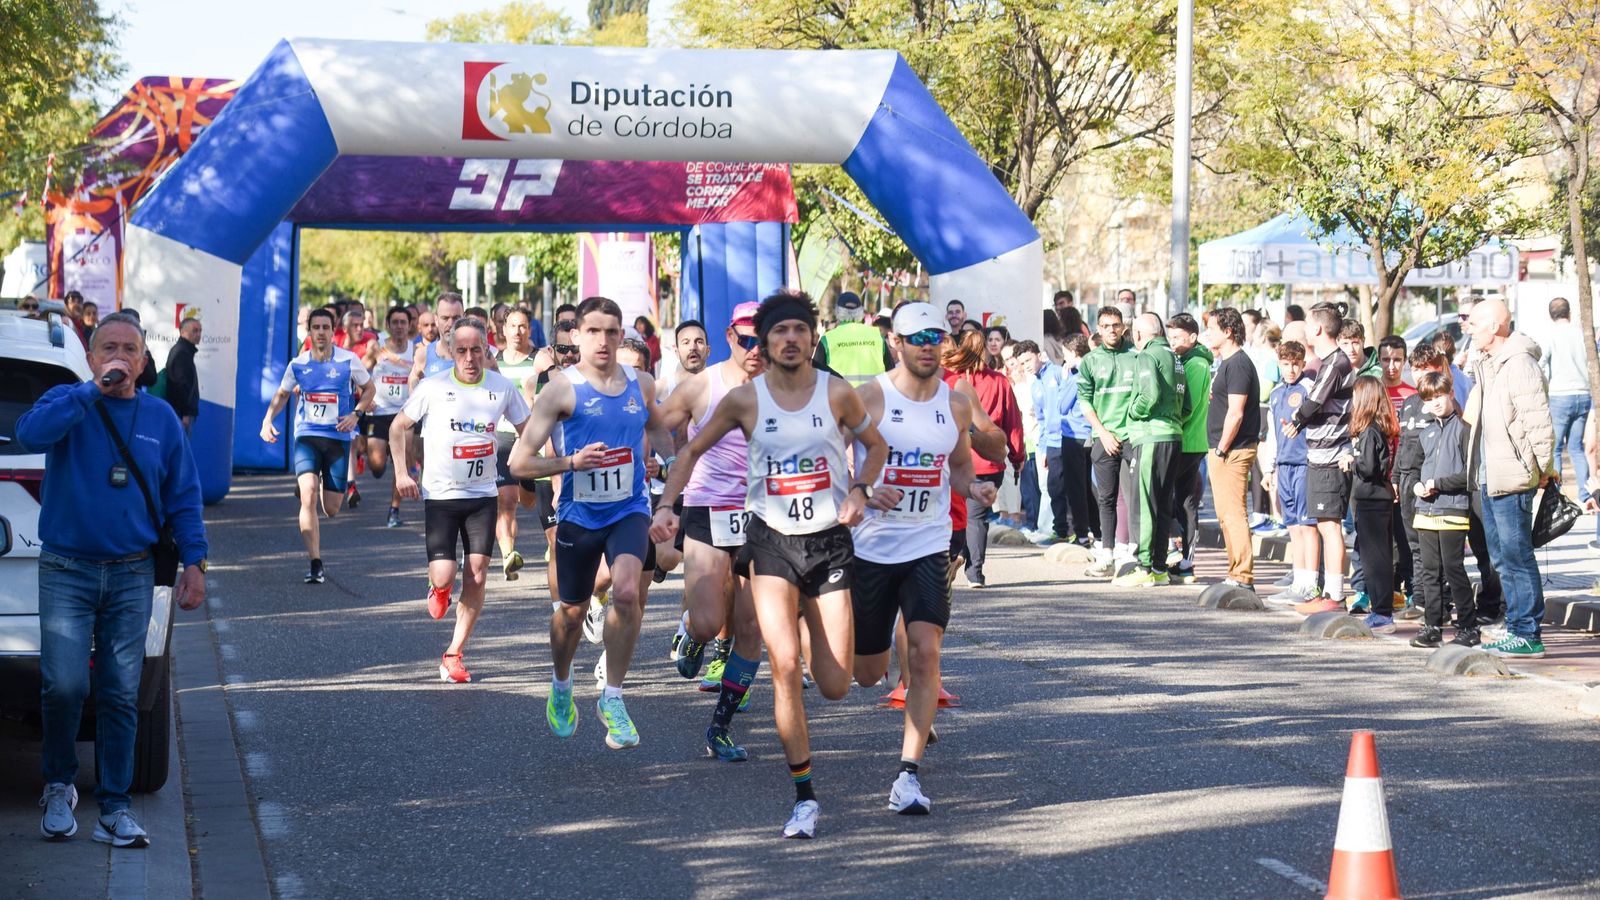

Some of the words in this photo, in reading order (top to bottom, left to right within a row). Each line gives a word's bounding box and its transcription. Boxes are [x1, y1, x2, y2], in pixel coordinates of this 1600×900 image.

[571, 81, 732, 111] Diputación
[568, 114, 602, 137] de
[614, 115, 732, 139] Córdoba
[686, 162, 703, 173] DE
[687, 174, 703, 185] SE
[705, 173, 744, 184] TRATA
[745, 172, 763, 183] DE
[686, 197, 729, 209] MEJOR
[837, 340, 876, 348] VOLUNTARIOS
[389, 385, 400, 397] 34
[313, 404, 327, 418] 27
[450, 418, 495, 433] indea
[767, 454, 828, 477] indea
[887, 446, 946, 468] indea
[467, 459, 484, 479] 76
[588, 468, 621, 491] 111
[788, 497, 814, 521] 48
